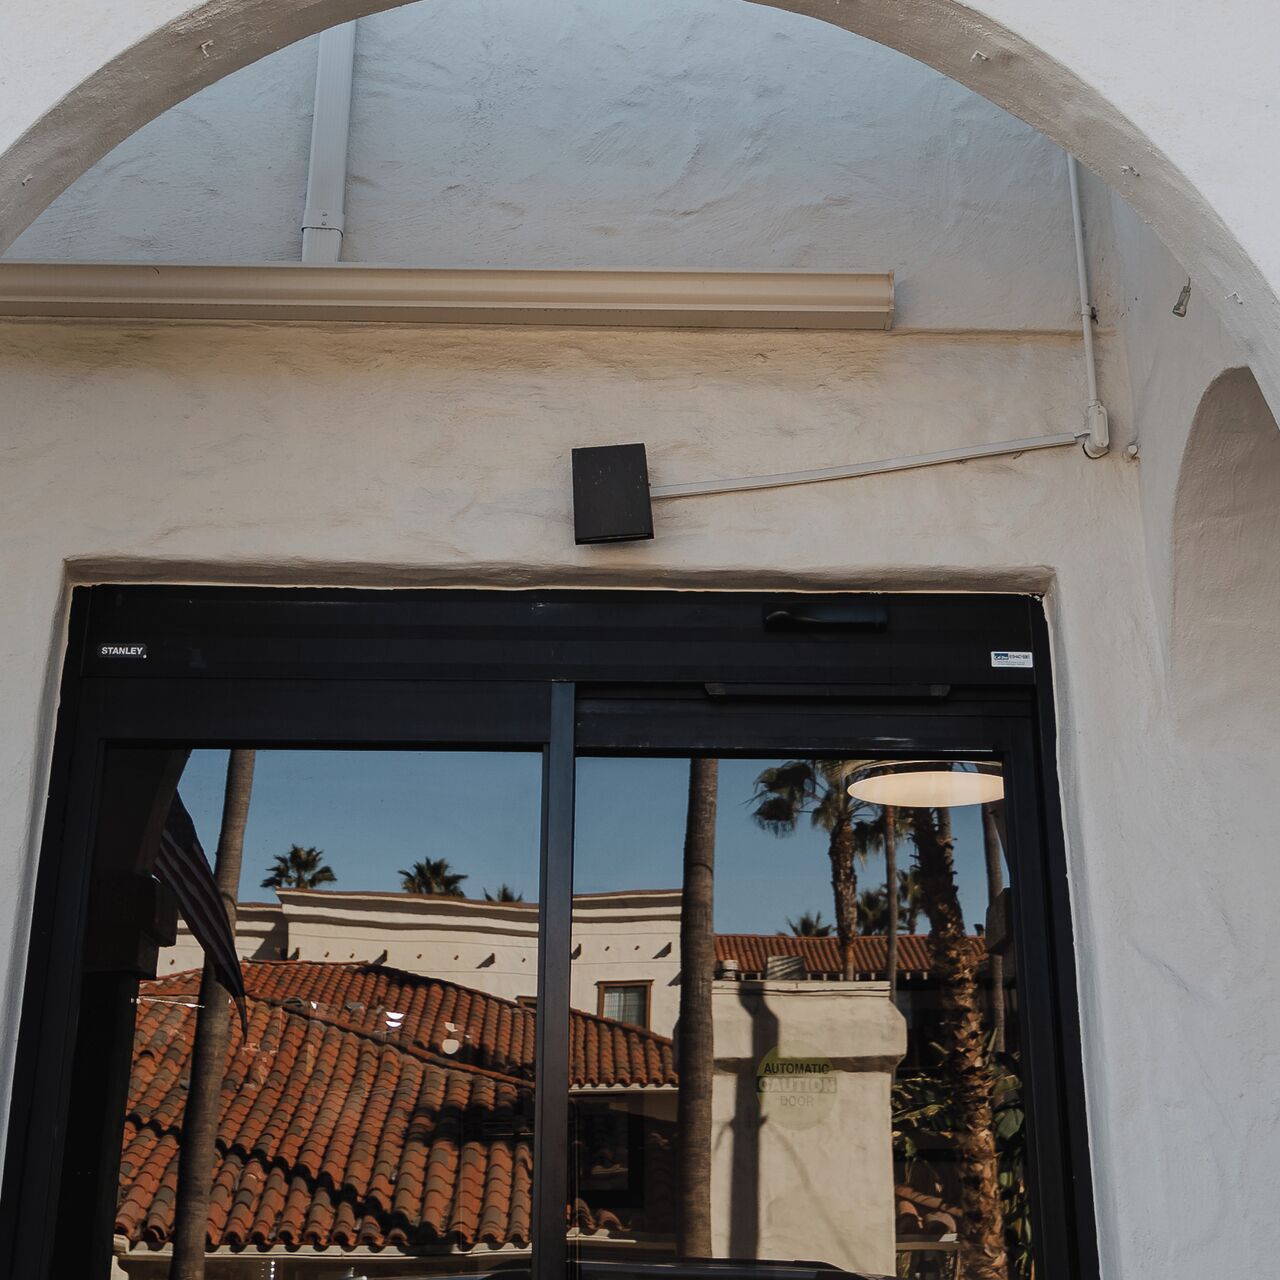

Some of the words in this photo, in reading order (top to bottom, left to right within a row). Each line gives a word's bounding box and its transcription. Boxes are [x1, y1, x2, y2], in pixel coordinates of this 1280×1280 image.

[101, 646, 144, 656] STANLEY
[764, 1063, 830, 1074] AUTOMATIC
[758, 1077, 837, 1093] CAUTION
[780, 1095, 814, 1107] DOOR
